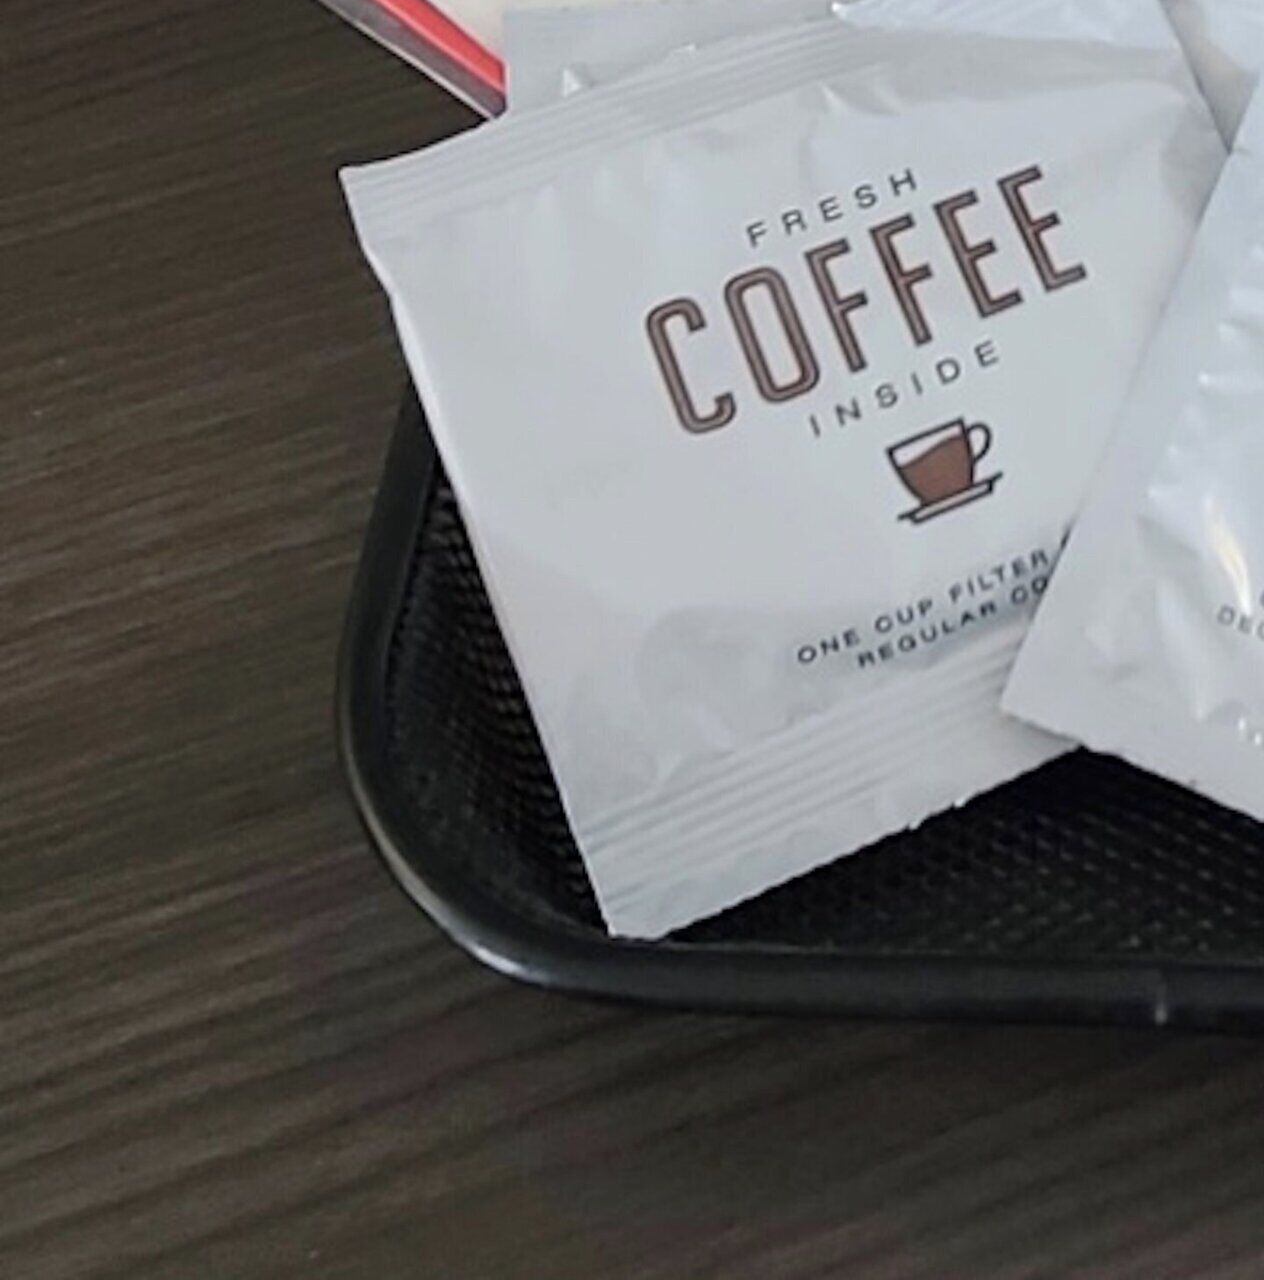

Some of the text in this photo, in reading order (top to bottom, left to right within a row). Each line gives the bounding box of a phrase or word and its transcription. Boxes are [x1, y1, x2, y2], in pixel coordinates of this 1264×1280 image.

[745, 169, 917, 248] FRESH
[644, 164, 1087, 435] COFFEE
[809, 340, 999, 437] INSIDE
[797, 549, 1049, 664] ONE CUP FILTER
[857, 600, 998, 668] REGULAR
